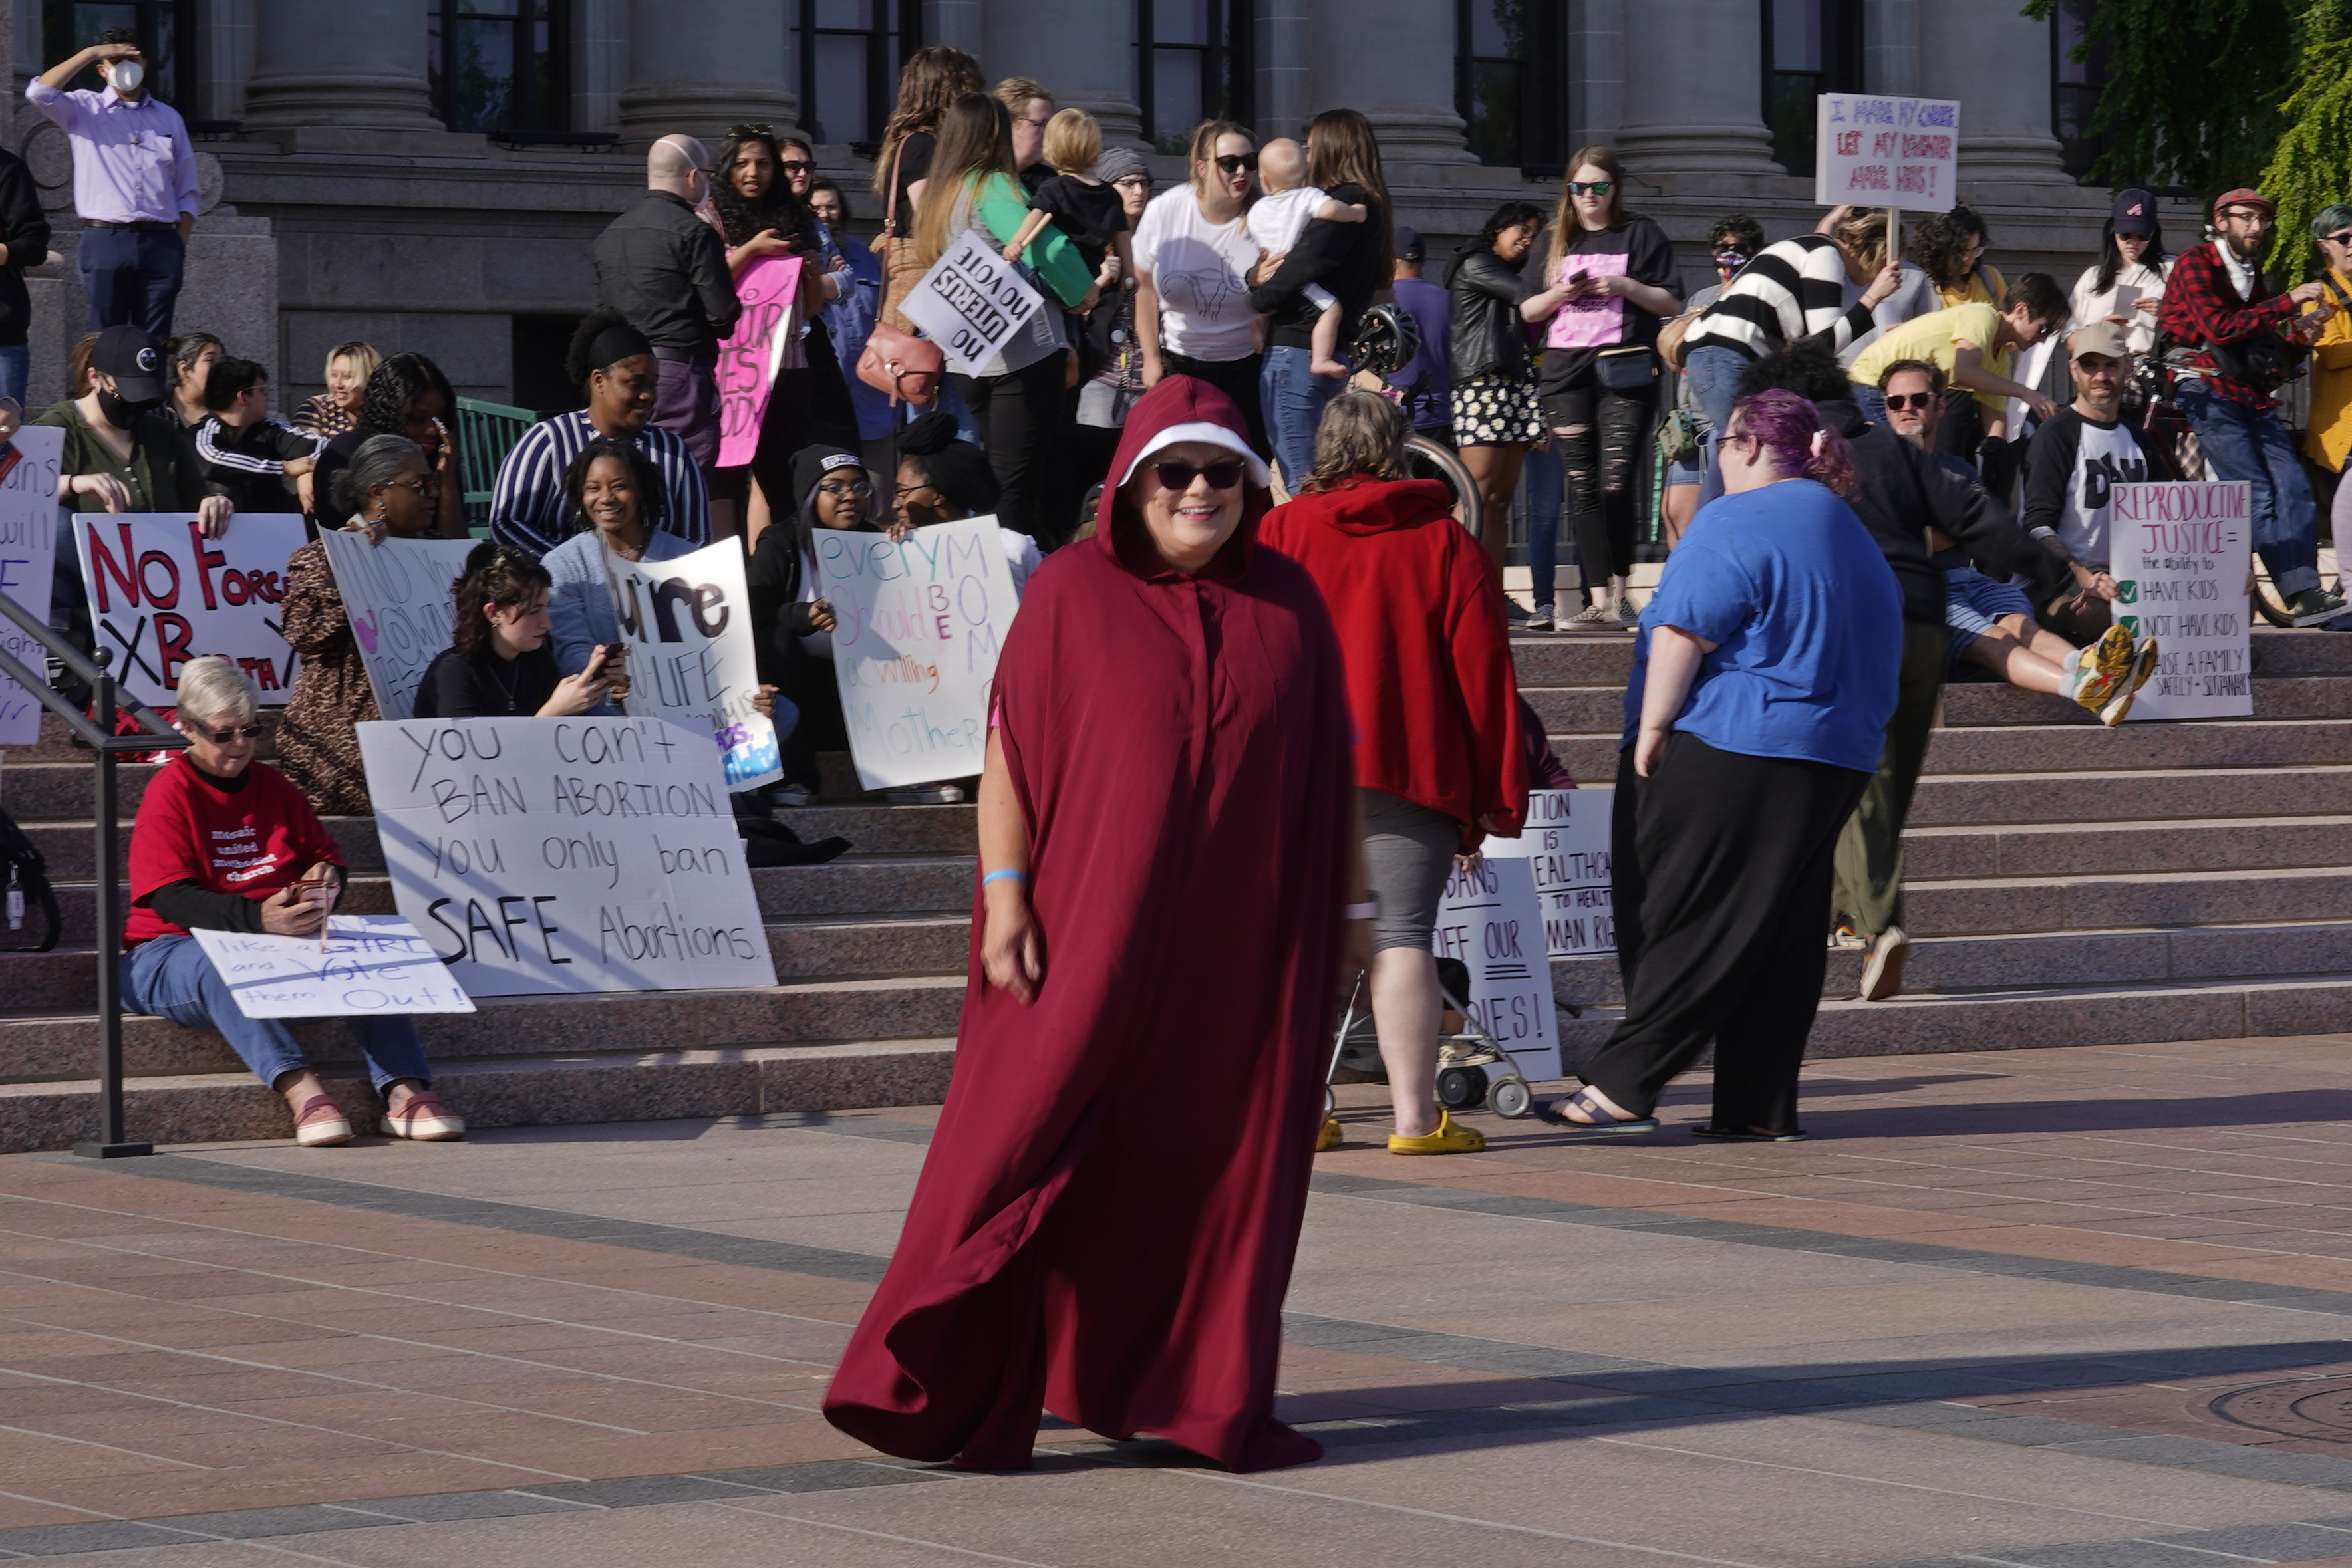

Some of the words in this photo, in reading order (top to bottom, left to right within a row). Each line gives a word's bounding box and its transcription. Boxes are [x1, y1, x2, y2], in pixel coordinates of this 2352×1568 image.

[1831, 100, 1846, 122] I
[1837, 130, 1864, 156] LET
[1872, 132, 1898, 158] MY
[953, 246, 1004, 295] VOTE
[933, 267, 1008, 344] UTERUS
[2113, 484, 2251, 521] REPRODUCTIVE
[2141, 520, 2226, 555] JUSTICE
[2142, 581, 2182, 601] HAVE
[2186, 579, 2219, 601] KIDS
[2143, 614, 2174, 636] NOT
[2177, 612, 2211, 638] HAVE
[2212, 612, 2240, 637] KIDS
[2152, 652, 2183, 676] AISE
[2198, 647, 2244, 674] FAMILY
[432, 774, 527, 824] BAN
[554, 775, 720, 819] ABORTION
[1544, 830, 1559, 851] IS
[653, 834, 730, 877] ban
[1552, 893, 1571, 910] TO
[428, 895, 573, 966] SAFE
[1484, 920, 1524, 960] OUR
[216, 938, 281, 954] like
[231, 960, 275, 974] and
[243, 989, 318, 1004] them
